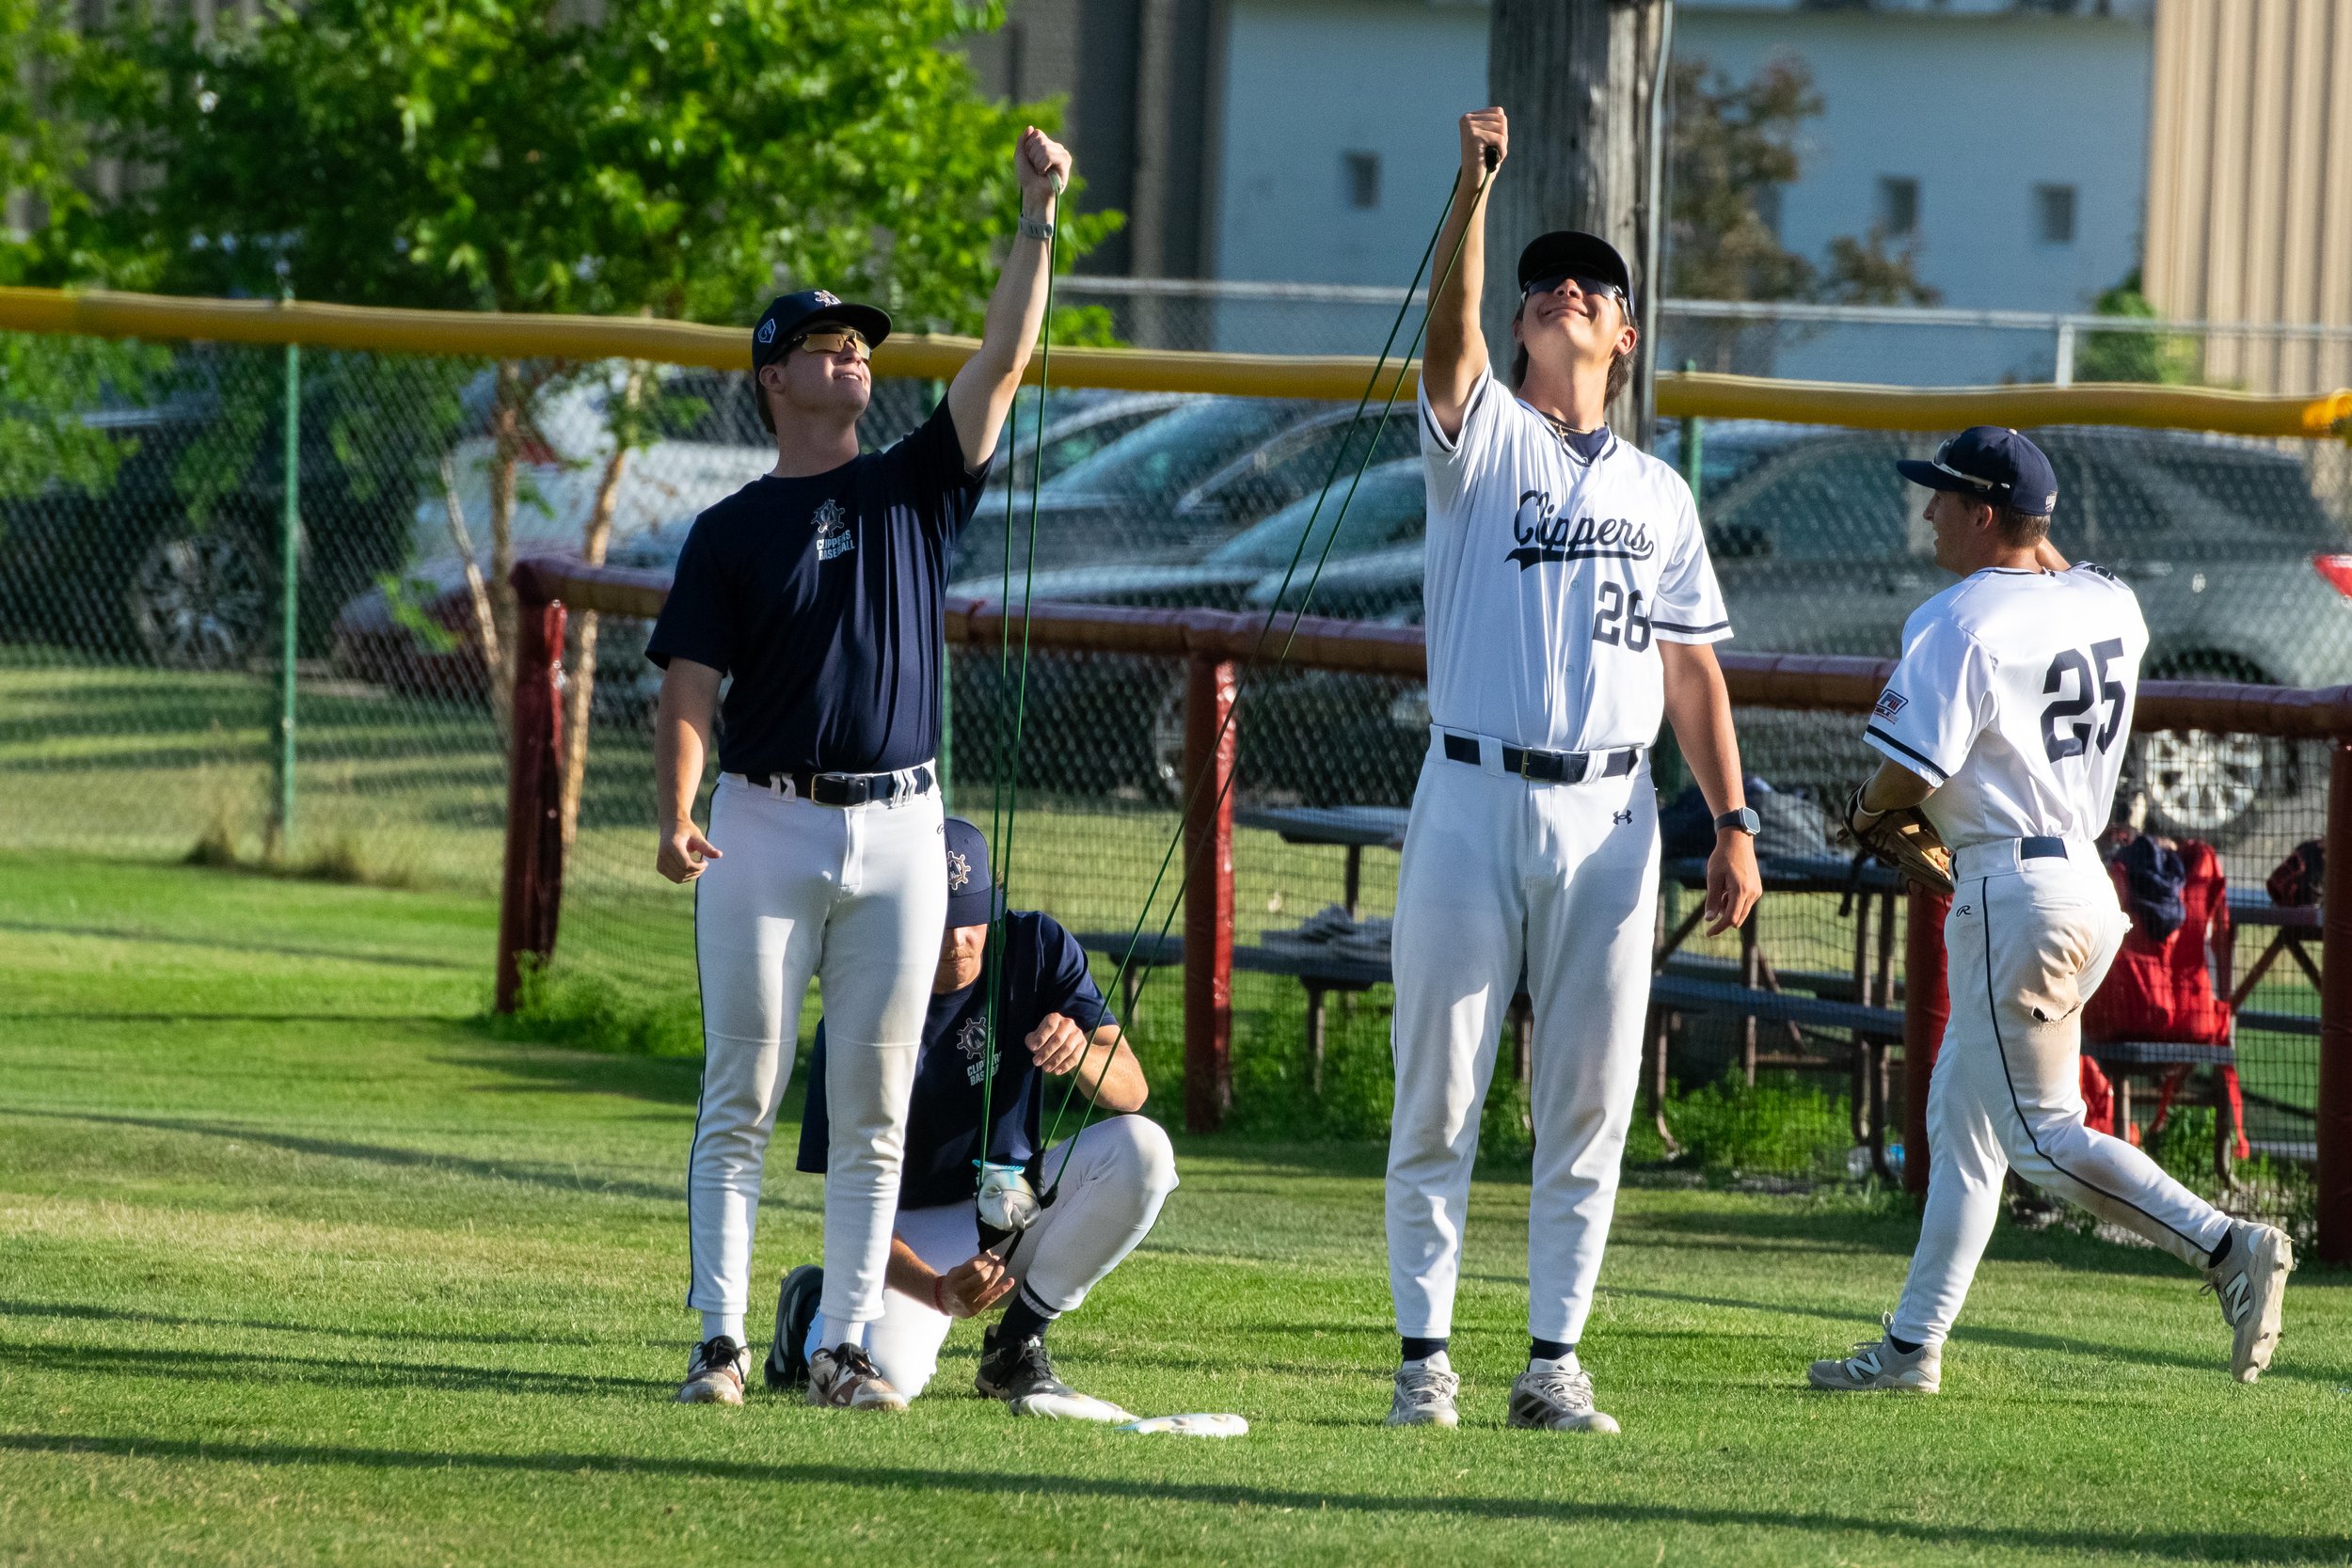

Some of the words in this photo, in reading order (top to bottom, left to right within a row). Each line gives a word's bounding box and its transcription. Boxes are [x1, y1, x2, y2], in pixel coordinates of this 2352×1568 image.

[817, 530, 850, 550] CLIPPERS
[1514, 490, 1654, 560] Clippers
[818, 540, 855, 561] BASEBALL
[2040, 637, 2125, 764] 25
